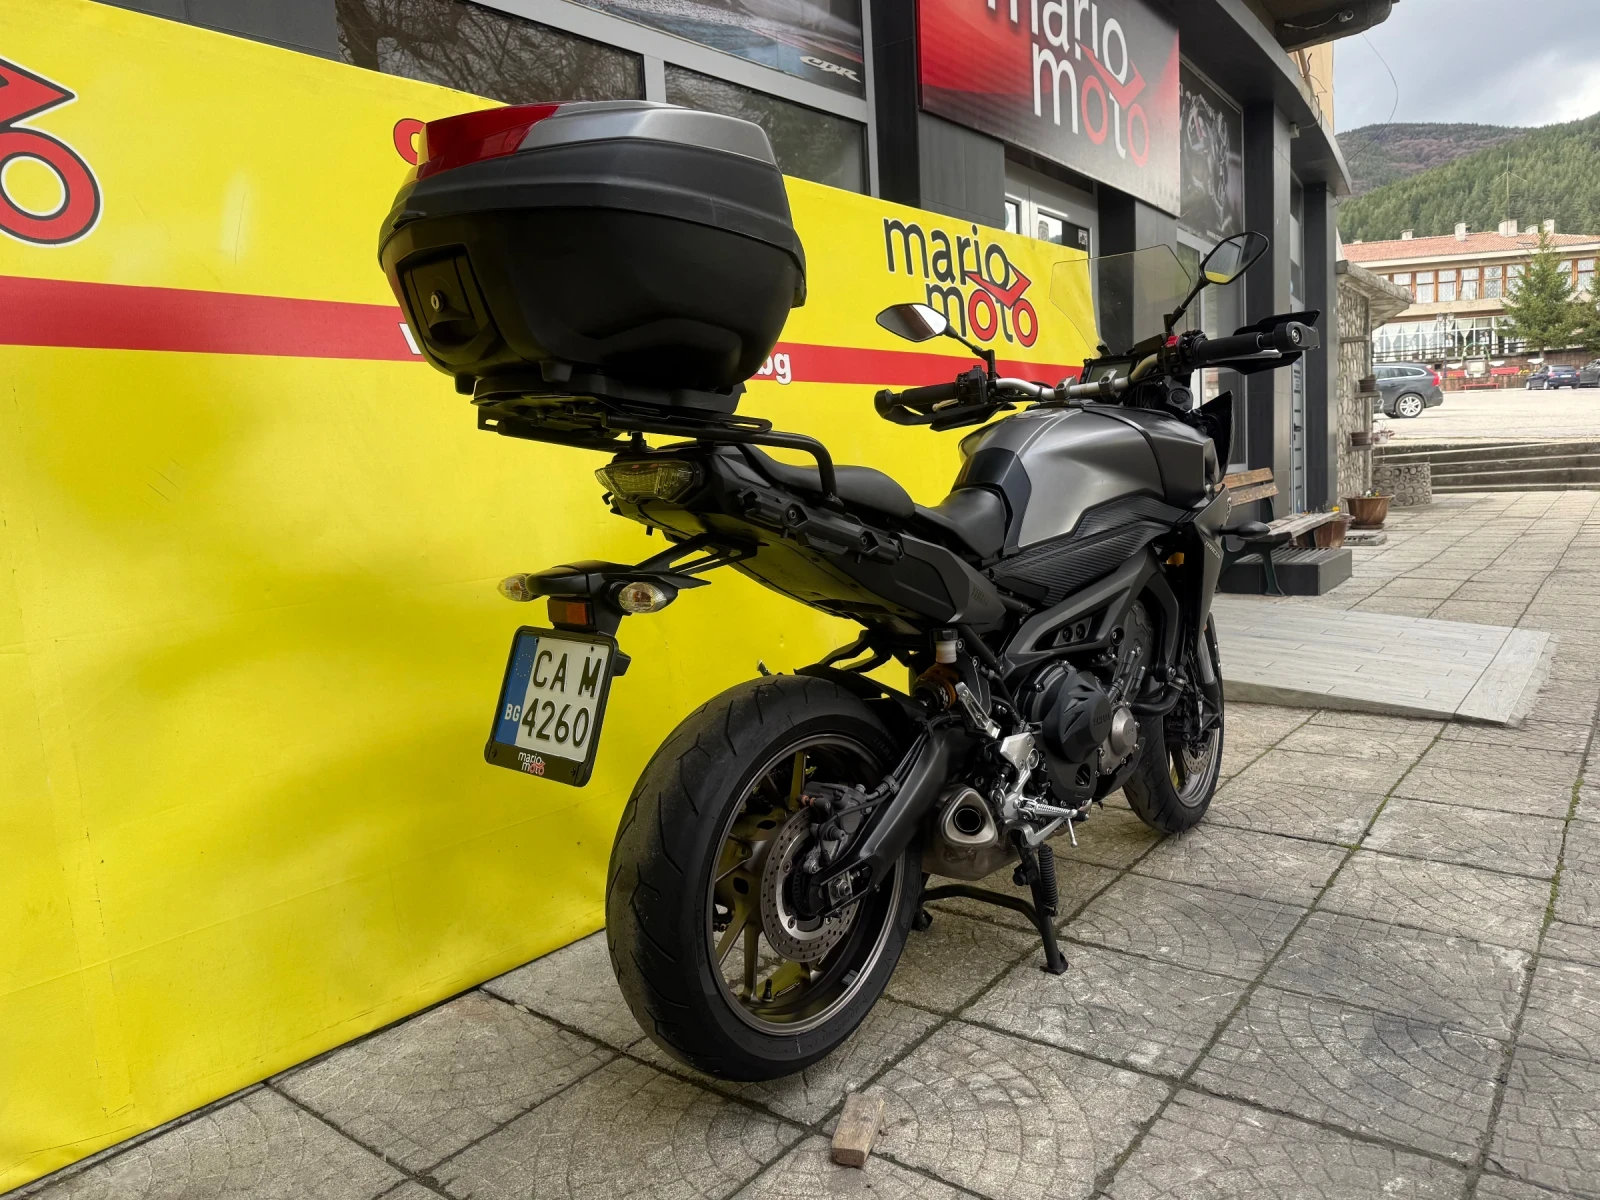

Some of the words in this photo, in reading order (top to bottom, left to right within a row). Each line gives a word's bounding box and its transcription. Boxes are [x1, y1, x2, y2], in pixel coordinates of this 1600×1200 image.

[799, 55, 862, 84] CBR
[1032, 42, 1150, 168] moto
[883, 218, 1011, 291] mario
[925, 283, 1039, 348] moto
[532, 650, 569, 693] CA
[577, 656, 603, 698] M
[504, 703, 521, 722] BG
[521, 697, 591, 748] 4260
[517, 751, 543, 765] mario
[521, 761, 545, 776] moto
